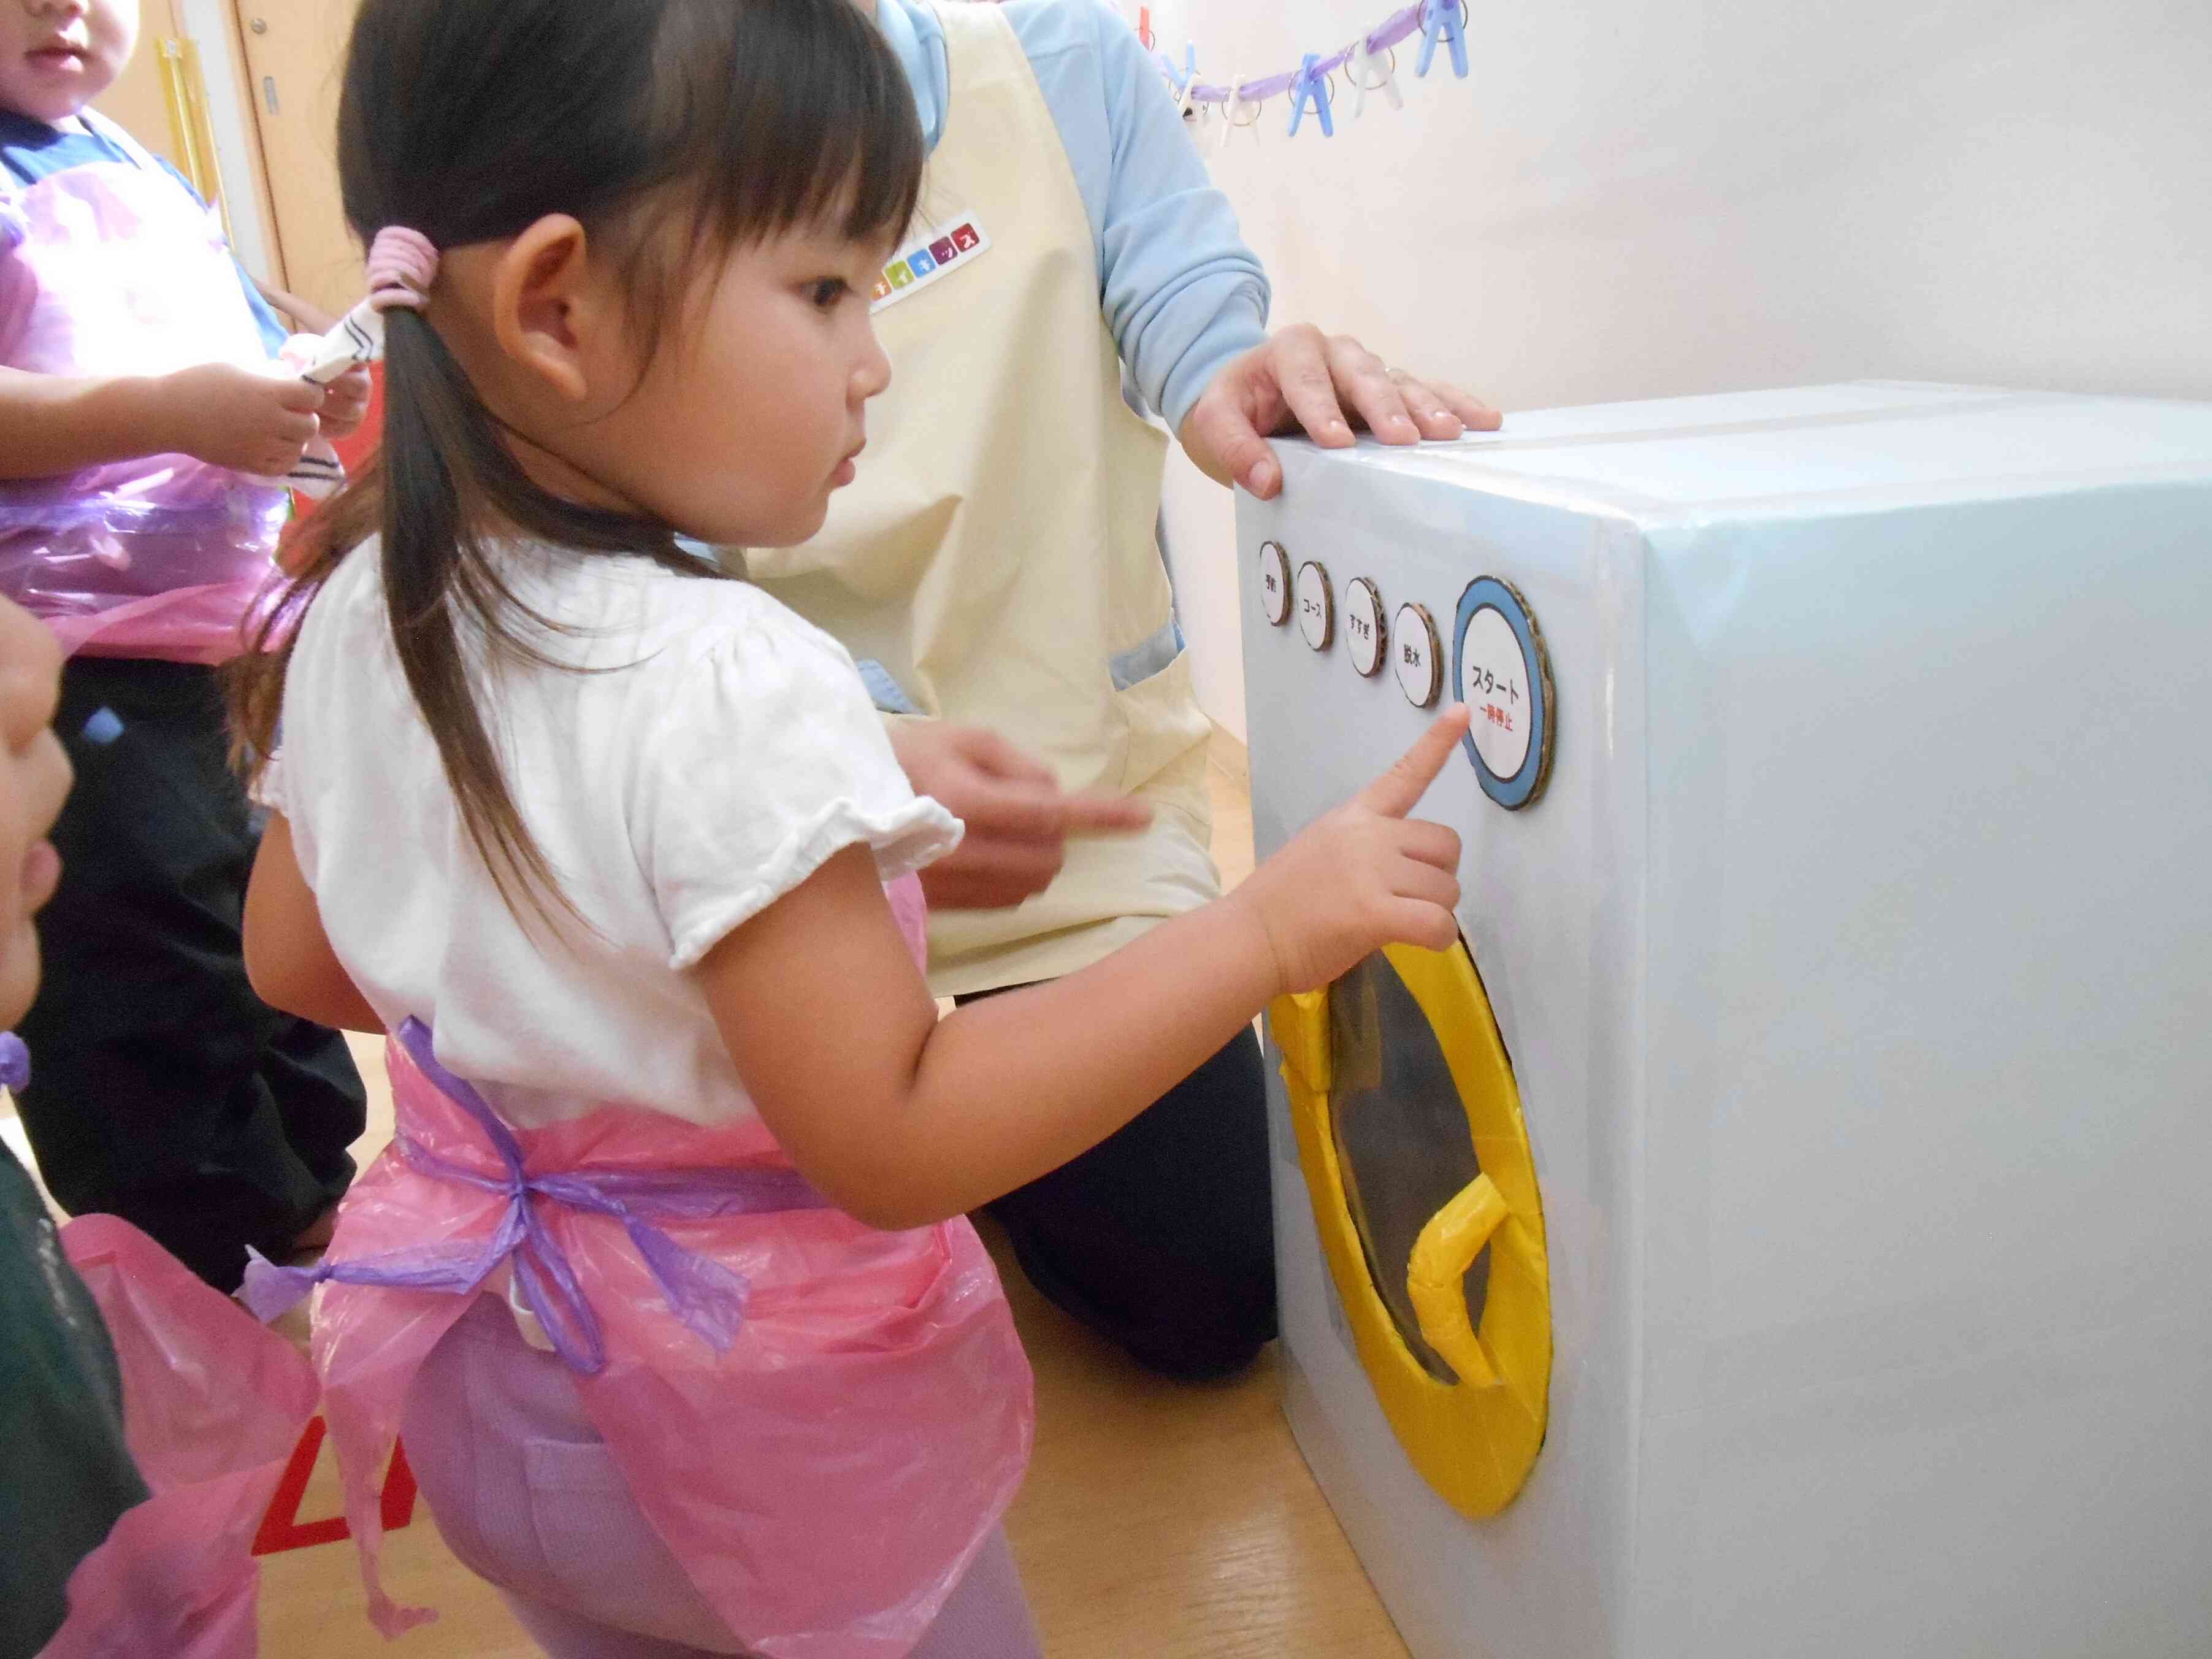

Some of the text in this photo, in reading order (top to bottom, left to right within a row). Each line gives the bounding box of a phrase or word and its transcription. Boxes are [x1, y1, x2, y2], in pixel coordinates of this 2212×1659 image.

[1303, 599, 1322, 619] コース
[1349, 614, 1369, 640] すすぎ
[1403, 643, 1422, 667] 脱水
[1472, 665, 1519, 705] スタート
[1479, 703, 1514, 732] 一時停止
